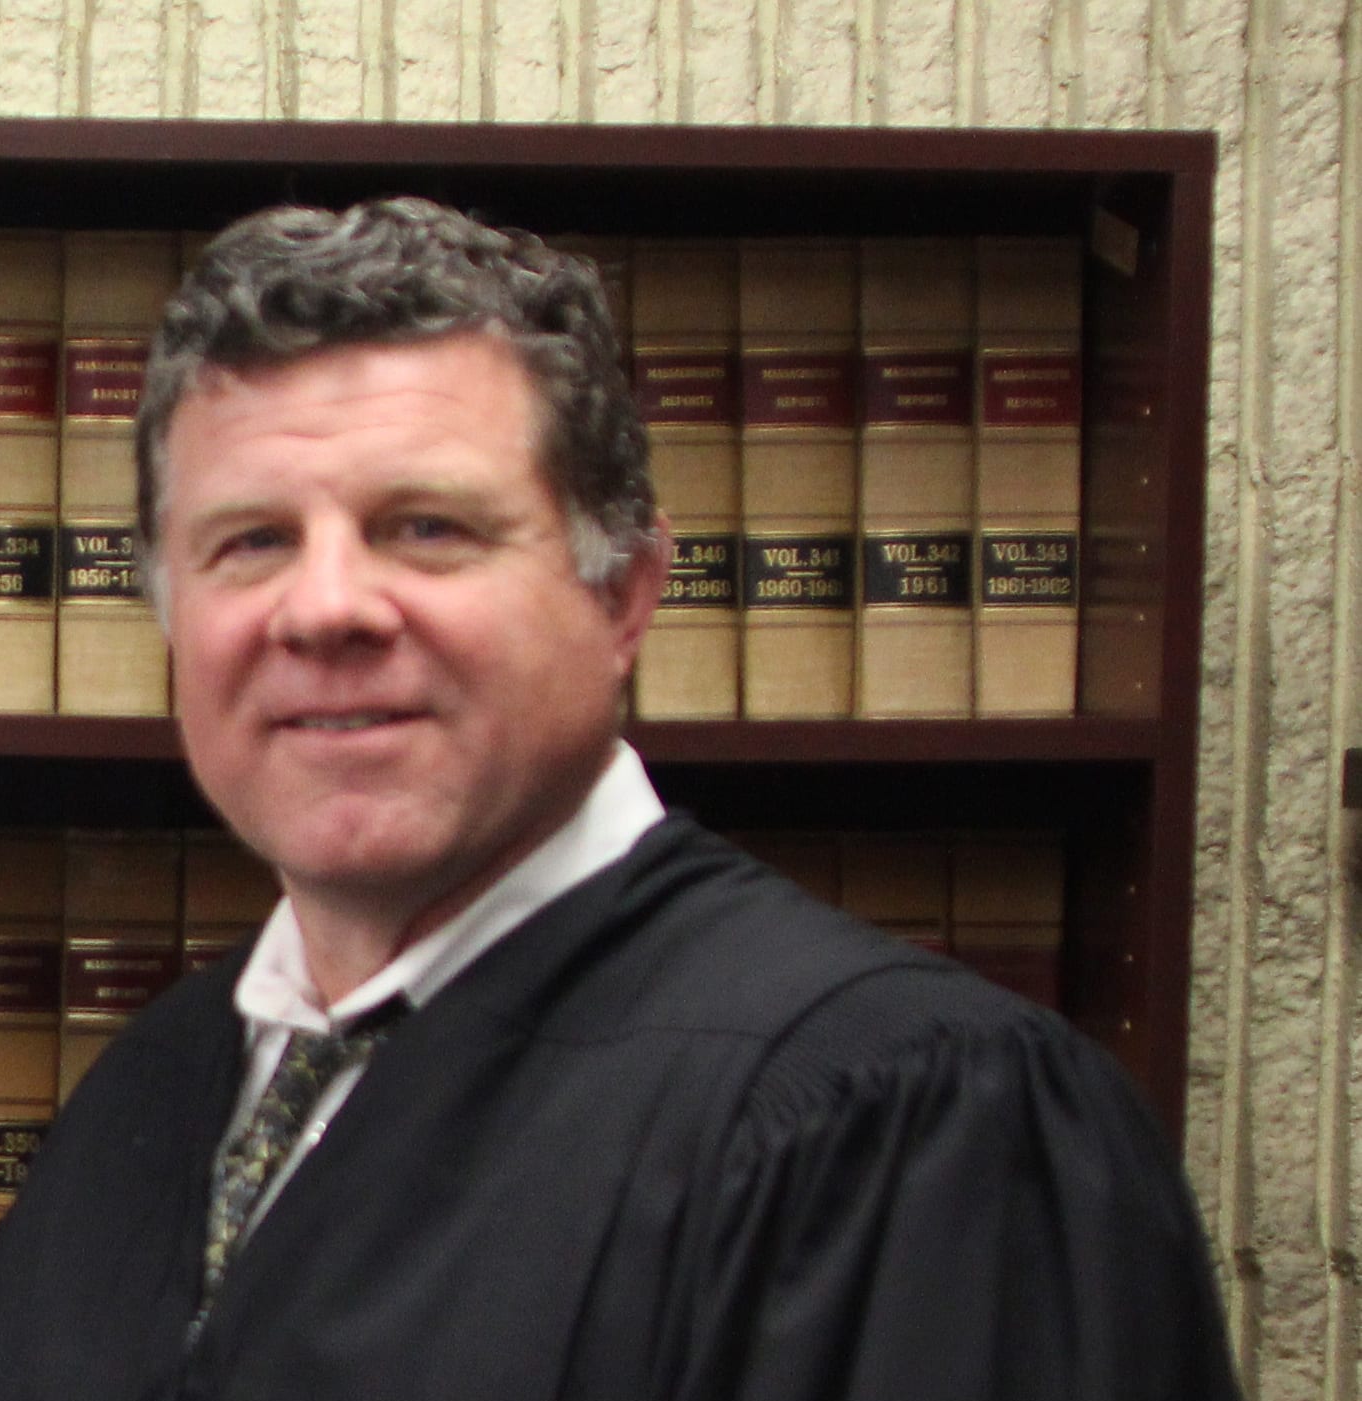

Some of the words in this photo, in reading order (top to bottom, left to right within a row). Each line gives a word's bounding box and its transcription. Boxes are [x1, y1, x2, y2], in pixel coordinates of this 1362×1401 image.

[660, 395, 714, 409] REPORTS
[992, 543, 1068, 563] VOL.343
[900, 575, 948, 596] 1961
[987, 576, 1071, 597] 1961-1962
